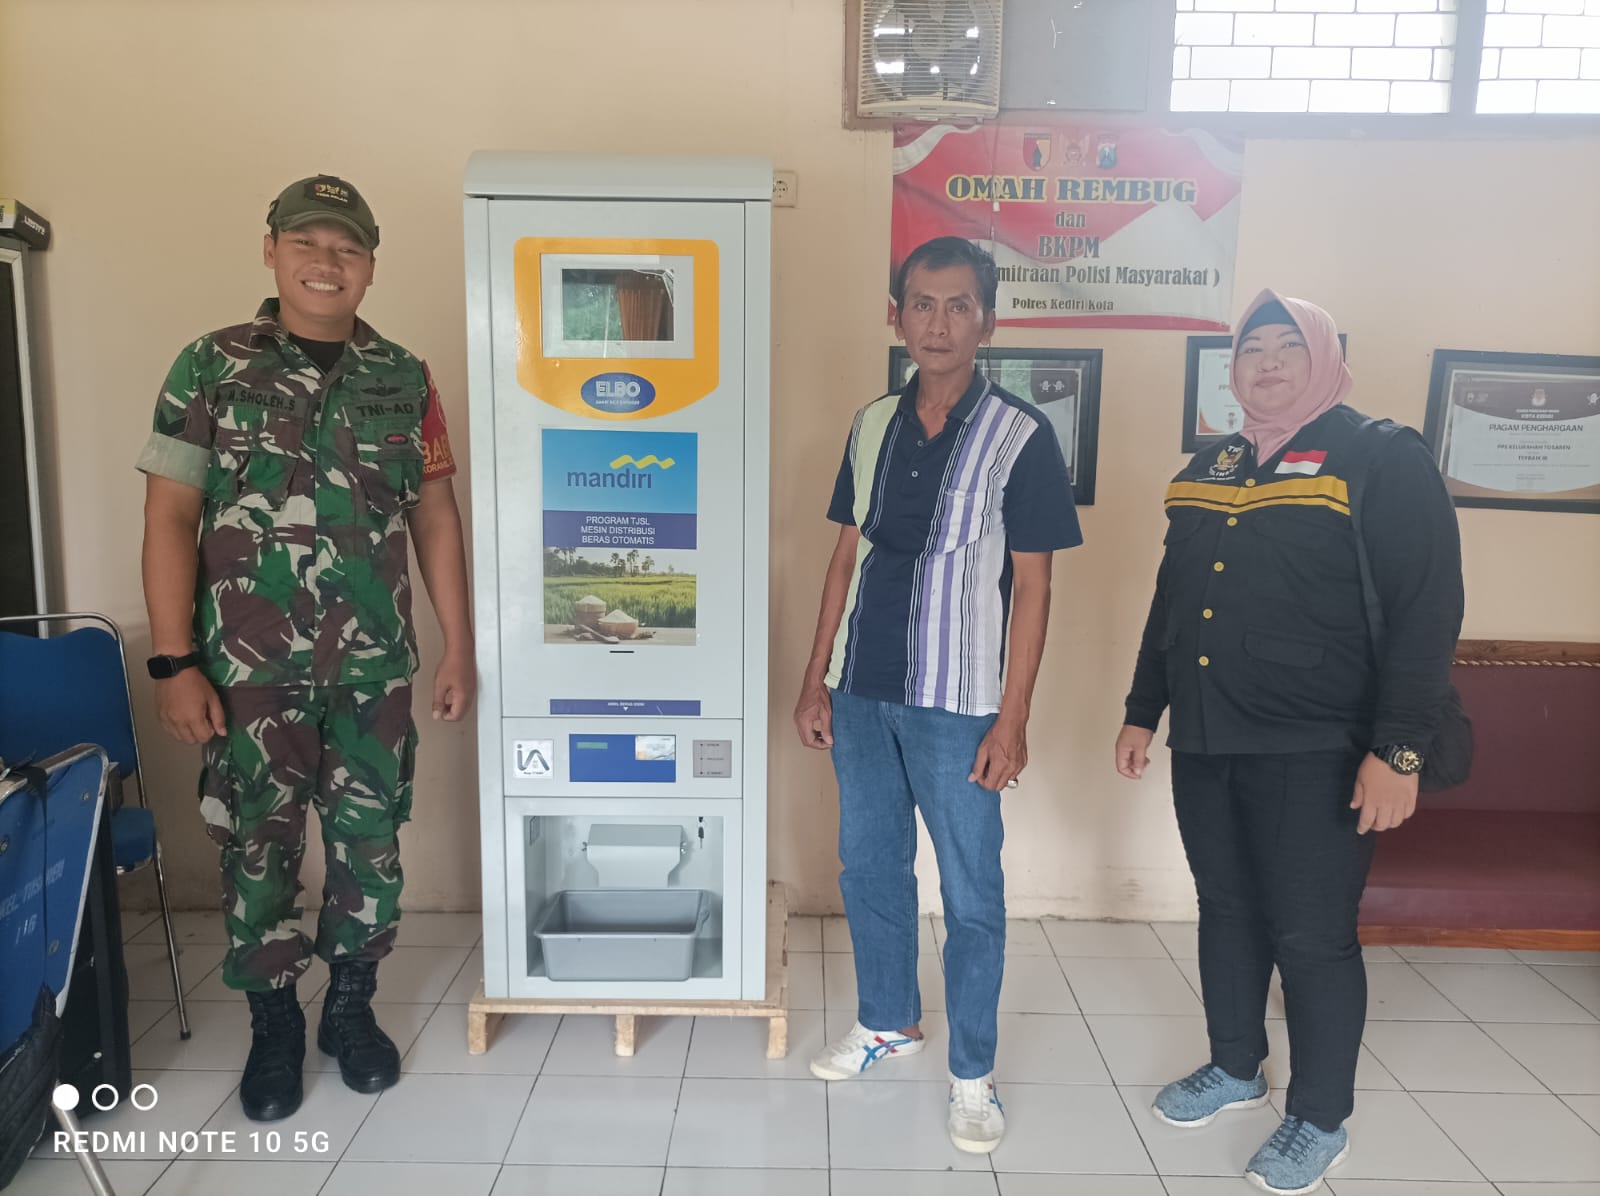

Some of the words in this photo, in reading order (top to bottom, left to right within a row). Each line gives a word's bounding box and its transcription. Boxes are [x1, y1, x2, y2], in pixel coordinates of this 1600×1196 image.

[946, 174, 1048, 202] OMAH
[1055, 177, 1198, 204] REMBUG
[1055, 211, 1087, 228] dan
[1038, 235, 1101, 259] BKPM
[1065, 265, 1111, 284] Polisi
[1115, 266, 1208, 287] Masyarakat
[1011, 297, 1048, 310] Polres
[1050, 298, 1085, 311] Kediri
[1088, 299, 1115, 312] Kota
[595, 381, 641, 398] ELBO
[355, 402, 415, 417] TNI-AD
[1488, 424, 1520, 432] PIAGAM
[1521, 424, 1584, 433] PENGHARGAAN
[567, 468, 652, 489] mandiri
[585, 516, 629, 525] PROGRAM
[630, 517, 651, 526] TJSL
[580, 525, 608, 535] MESIN
[608, 526, 656, 536] DISTRIBUSI
[581, 535, 611, 544] BERAS
[611, 536, 655, 545] OTOMATIS
